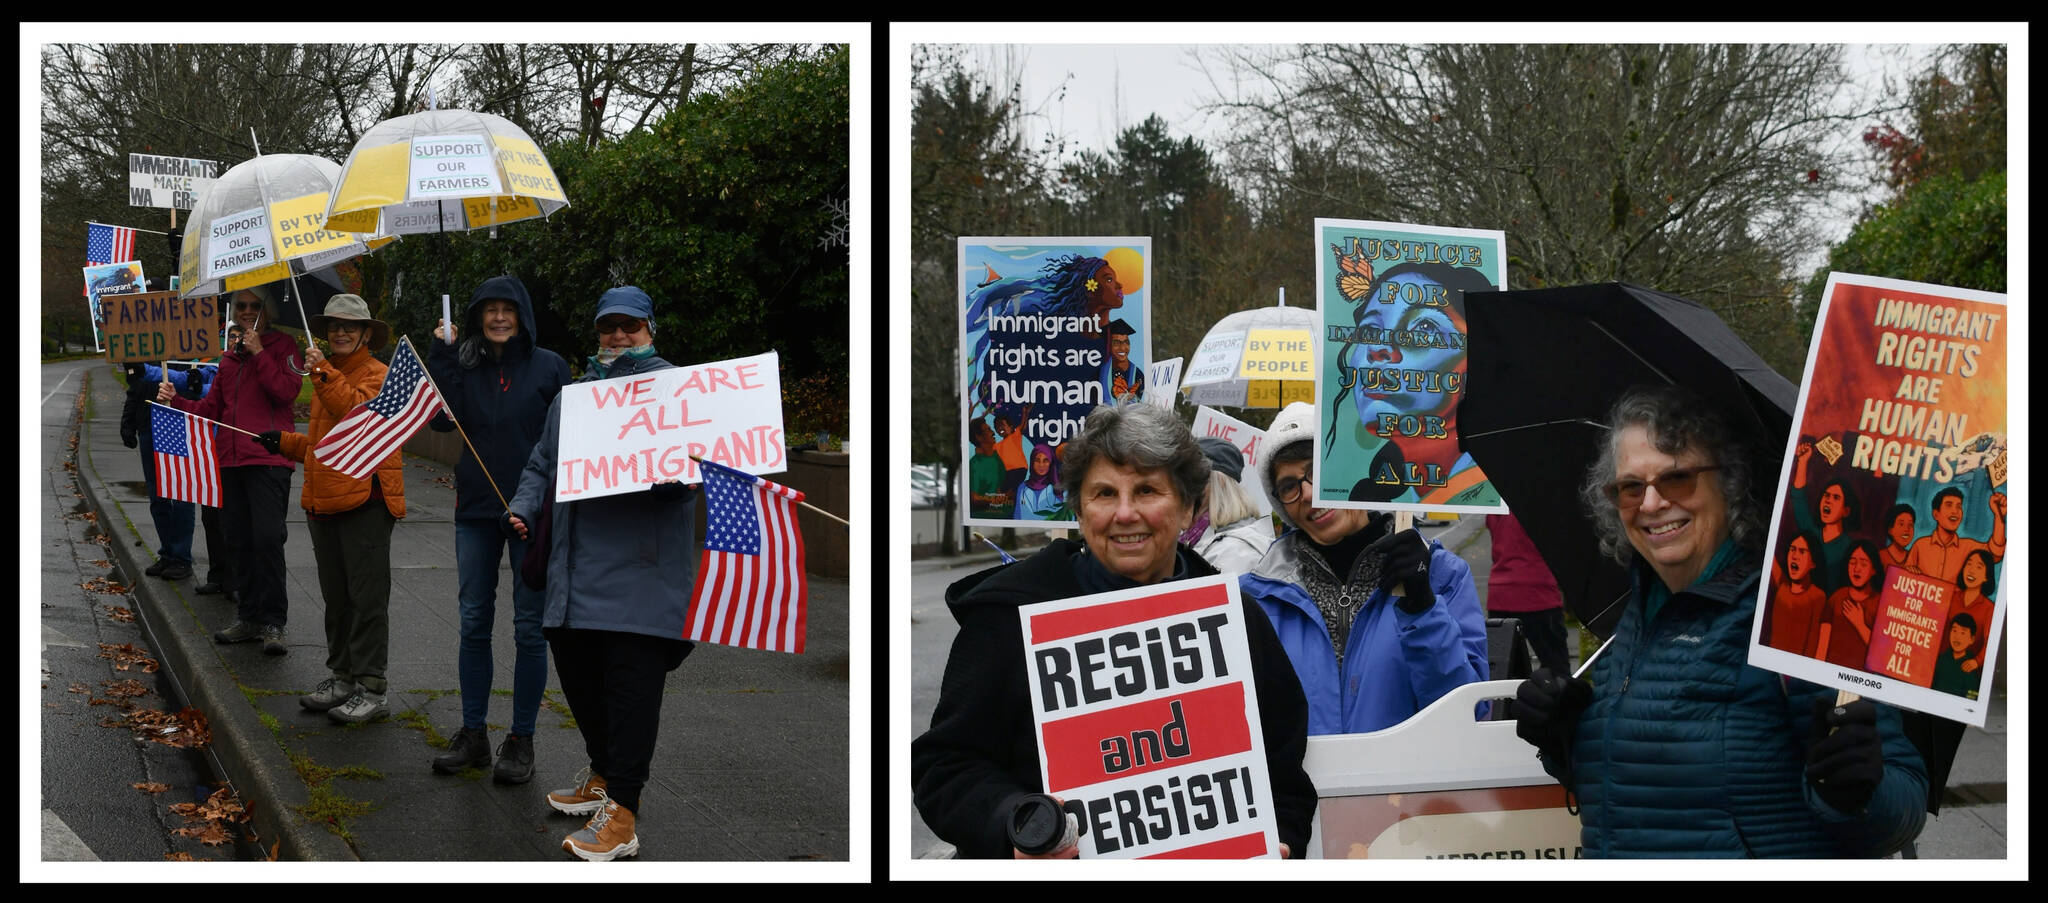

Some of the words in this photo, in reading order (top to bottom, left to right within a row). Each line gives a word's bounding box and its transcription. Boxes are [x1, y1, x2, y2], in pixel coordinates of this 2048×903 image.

[415, 143, 483, 157] SUPPORT
[517, 151, 542, 167] THE
[437, 162, 466, 172] OUR
[153, 175, 192, 191] MAKE
[419, 177, 489, 190] FARMERS
[512, 172, 556, 192] PEOPLE
[130, 187, 153, 207] WA
[213, 215, 265, 238] SUPPORT
[280, 217, 299, 232] BY
[303, 212, 324, 227] TH
[229, 236, 251, 249] OUR
[1341, 236, 1483, 266] JUSTICE
[214, 248, 266, 270] FARMERS
[1378, 281, 1449, 307] FOR
[103, 296, 214, 326] FARMERS
[988, 307, 1103, 340] Immigrant
[1874, 298, 2001, 342] IMMIGRANT
[108, 331, 165, 359] FEED
[178, 328, 209, 353] US
[1203, 338, 1243, 352] SUPPORT
[1250, 340, 1272, 351] BY
[1277, 340, 1307, 351] THE
[1328, 325, 1466, 350] IMMIGRAN
[989, 343, 1060, 374] rights
[1064, 349, 1102, 367] are
[1209, 353, 1226, 363] OUR
[1246, 360, 1308, 372] PEOPLE
[1876, 331, 1981, 378] RIGHTS
[1191, 366, 1230, 378] FARMERS
[1338, 366, 1466, 393] JUSTIC
[591, 377, 657, 410] WE
[673, 363, 765, 398] ARE
[990, 371, 1104, 406] human
[1895, 374, 1944, 404] ARE
[617, 399, 713, 440] ALL
[1028, 412, 1086, 446] right
[1207, 417, 1238, 443] WE
[1376, 412, 1449, 439] FOR
[1858, 398, 1968, 448] HUMAN
[560, 425, 783, 496] IMMIGRANTS
[1851, 434, 1959, 484] RIGHTS
[1375, 461, 1448, 488] ALL
[1892, 575, 1944, 604] JUSTICE
[1904, 597, 1922, 612] FOR
[1883, 621, 1933, 649] JUSTICE
[1894, 642, 1912, 657] FOR
[1837, 671, 1883, 690] NWIRP.ORG
[1886, 657, 1911, 678] ALL
[1100, 699, 1192, 774] and
